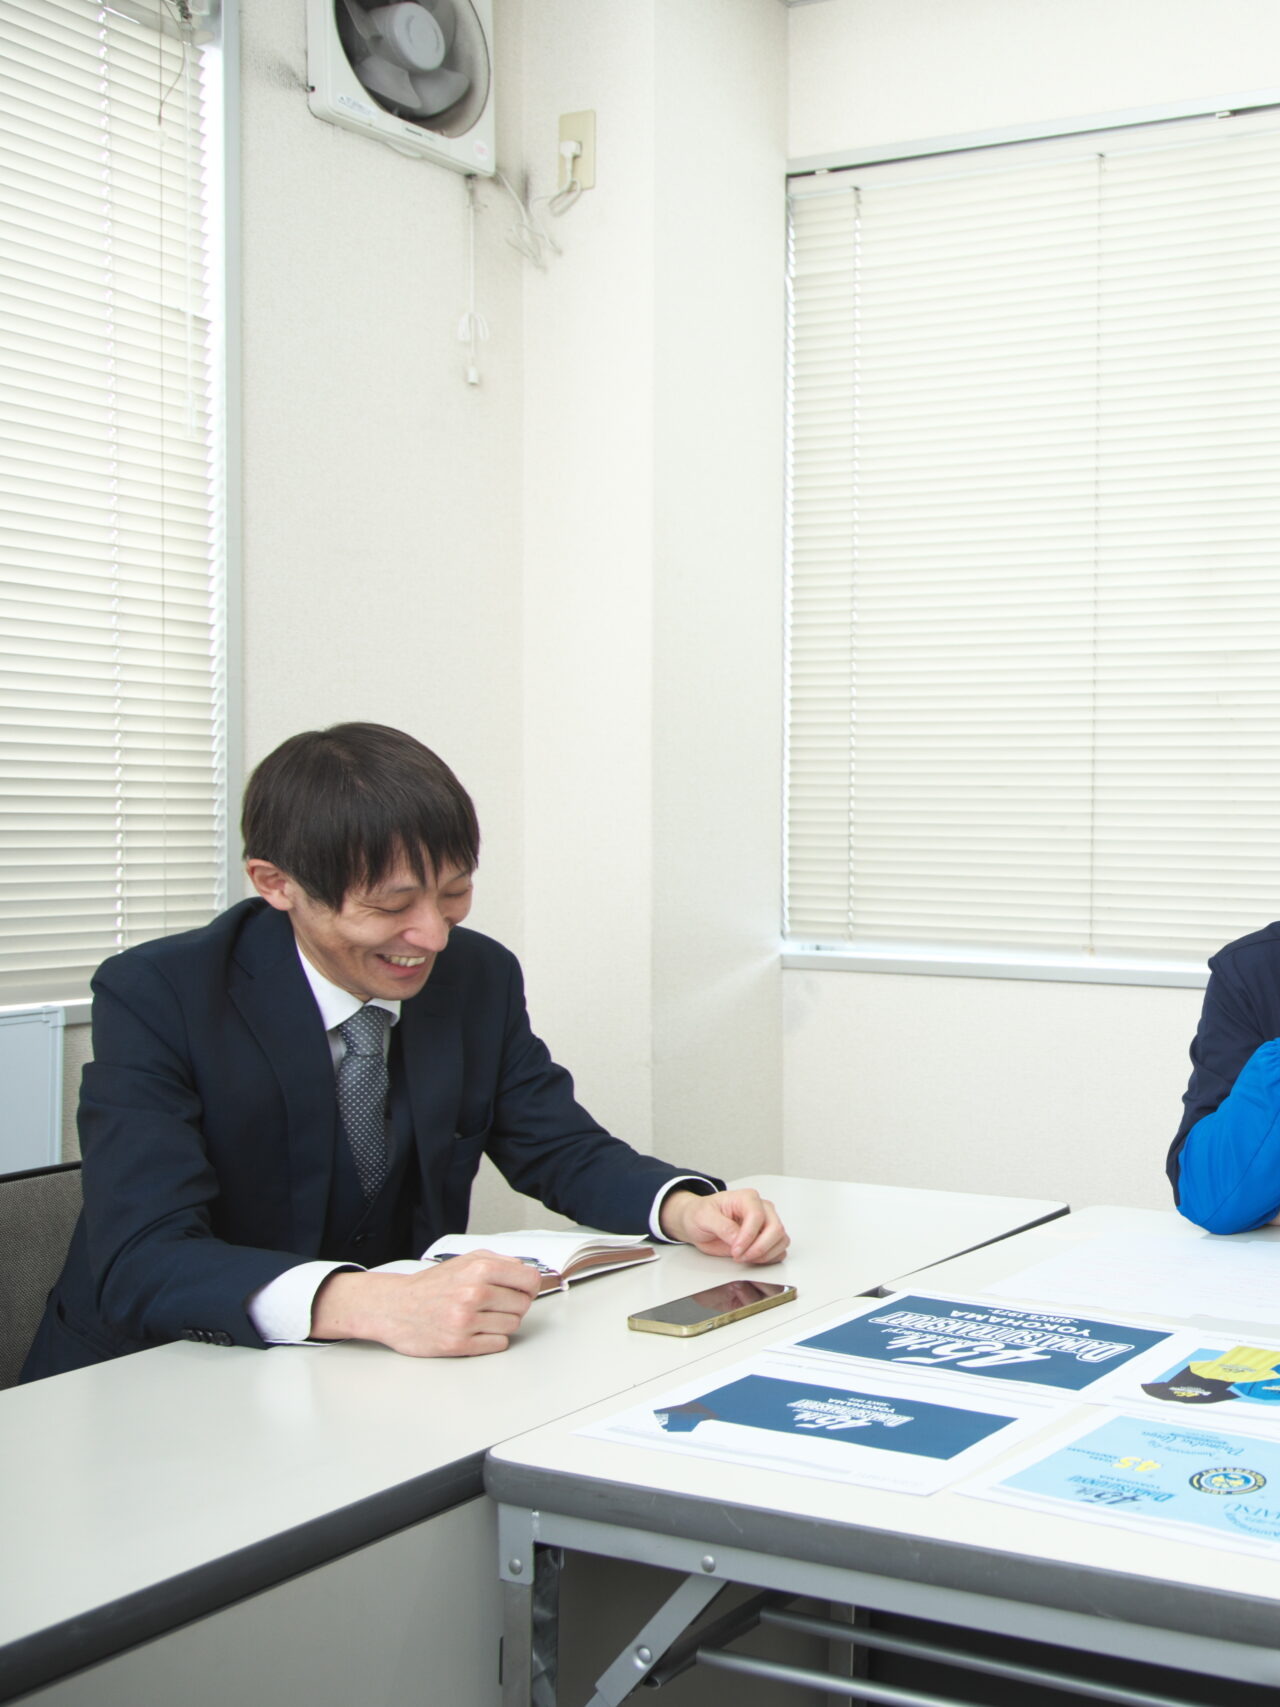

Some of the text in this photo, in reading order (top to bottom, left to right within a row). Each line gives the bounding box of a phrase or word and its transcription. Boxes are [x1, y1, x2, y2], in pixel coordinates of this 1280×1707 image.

[868, 1311, 1135, 1363] DAIMATSU TRANSPORT
[950, 1310, 1091, 1337] YOKOHAMA
[1113, 1456, 1162, 1472] 45
